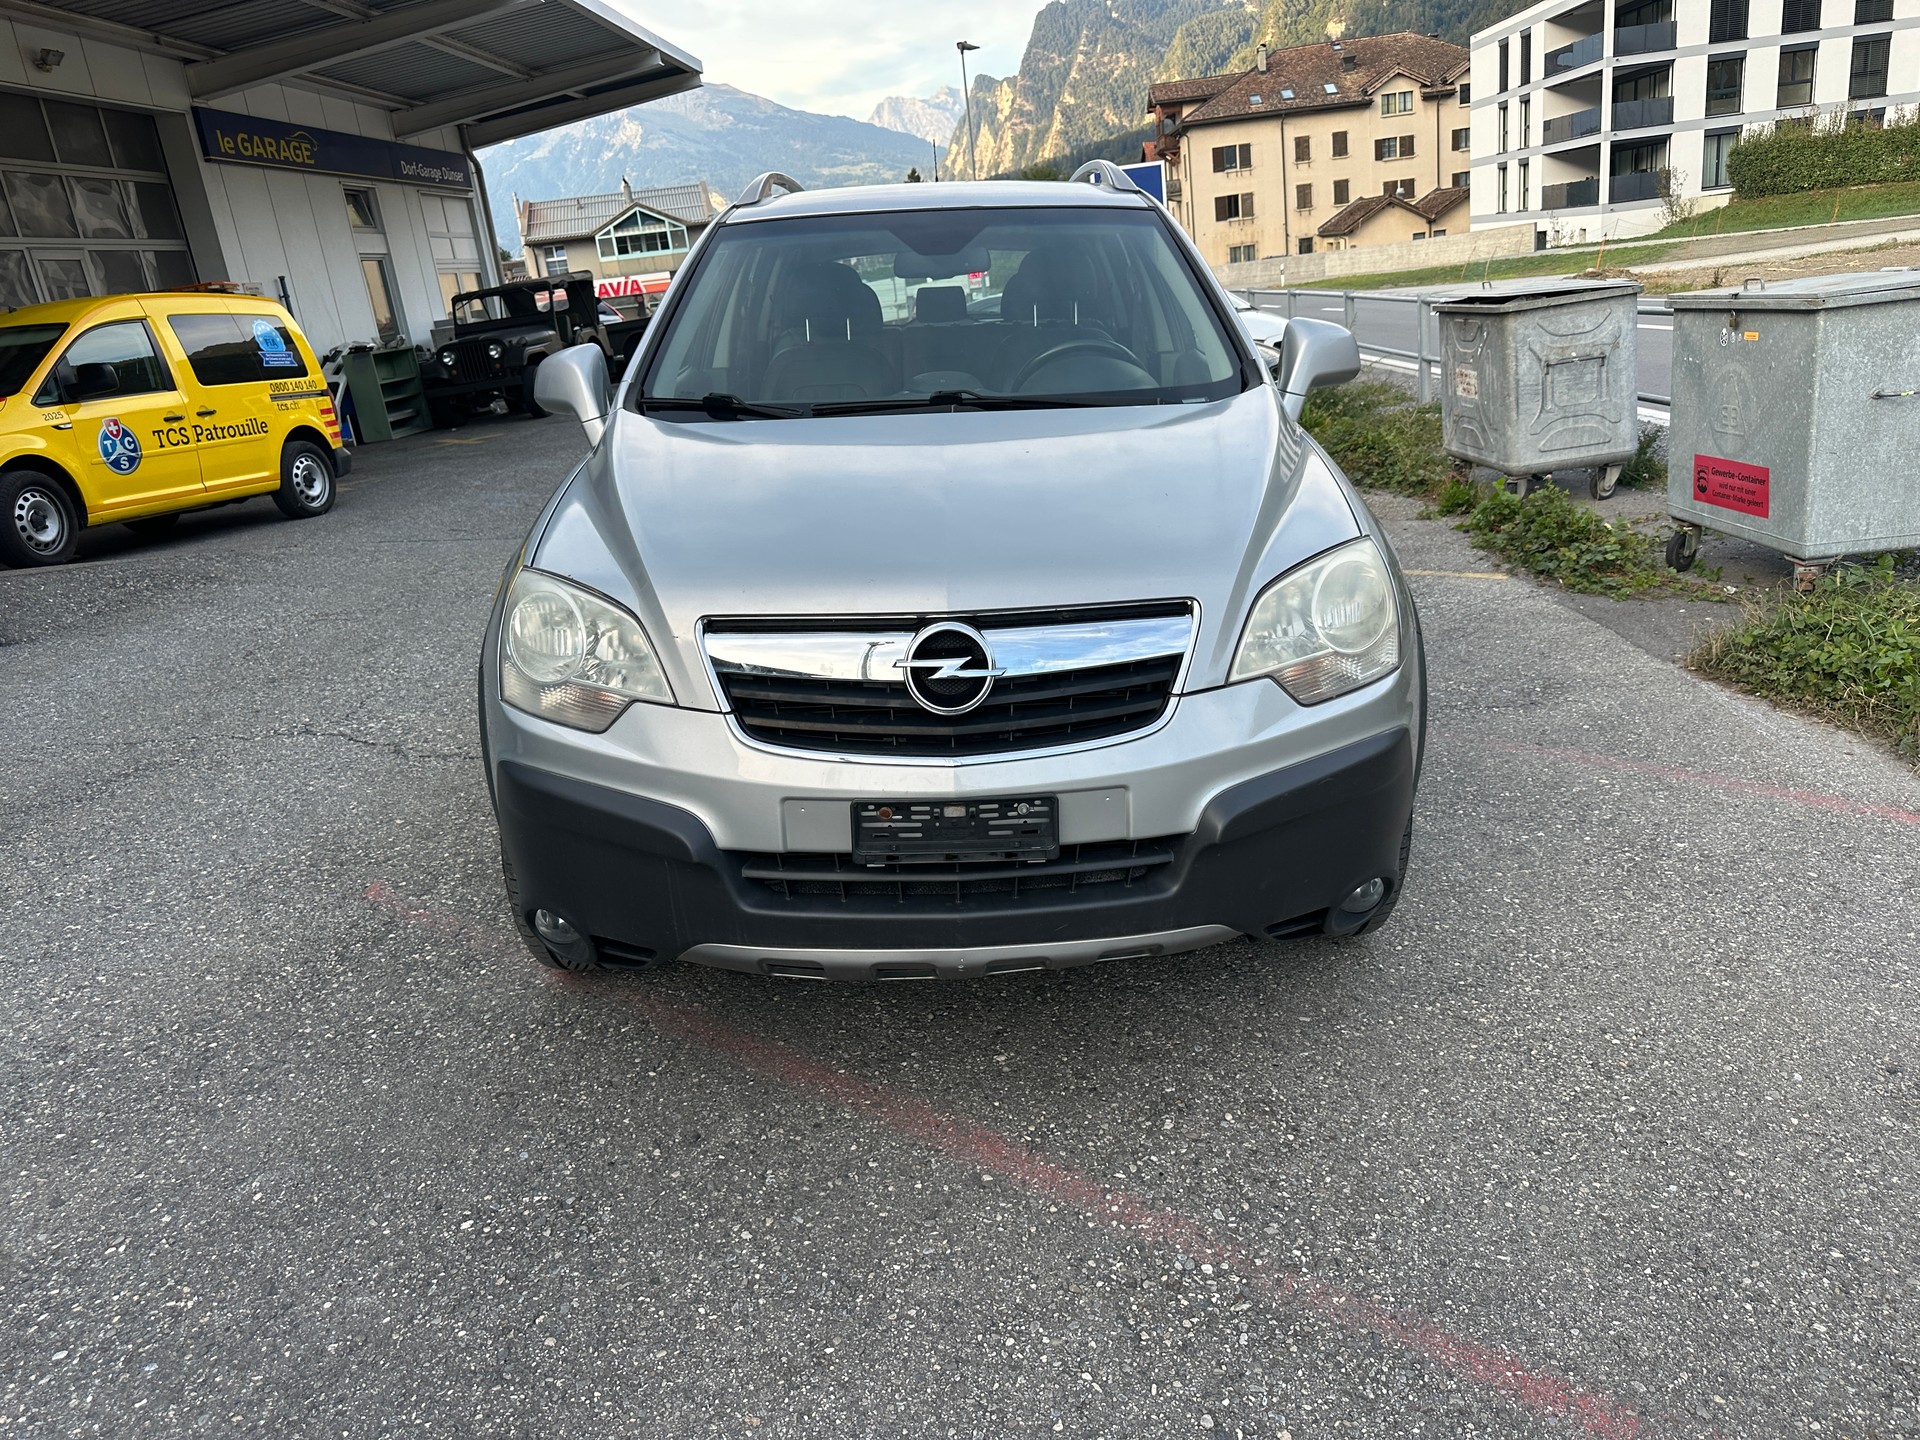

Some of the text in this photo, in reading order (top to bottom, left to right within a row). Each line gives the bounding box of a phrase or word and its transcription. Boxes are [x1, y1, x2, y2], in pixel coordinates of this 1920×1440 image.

[216, 129, 315, 164] le GARAGE
[401, 161, 442, 182] Dorf-Garage
[269, 379, 318, 393] 0800 140 140
[42, 411, 65, 421] 2025
[276, 401, 301, 411] tcs.ch
[152, 417, 269, 448] TCS Patrouille
[1711, 466, 1767, 487] Gewerbe-Container
